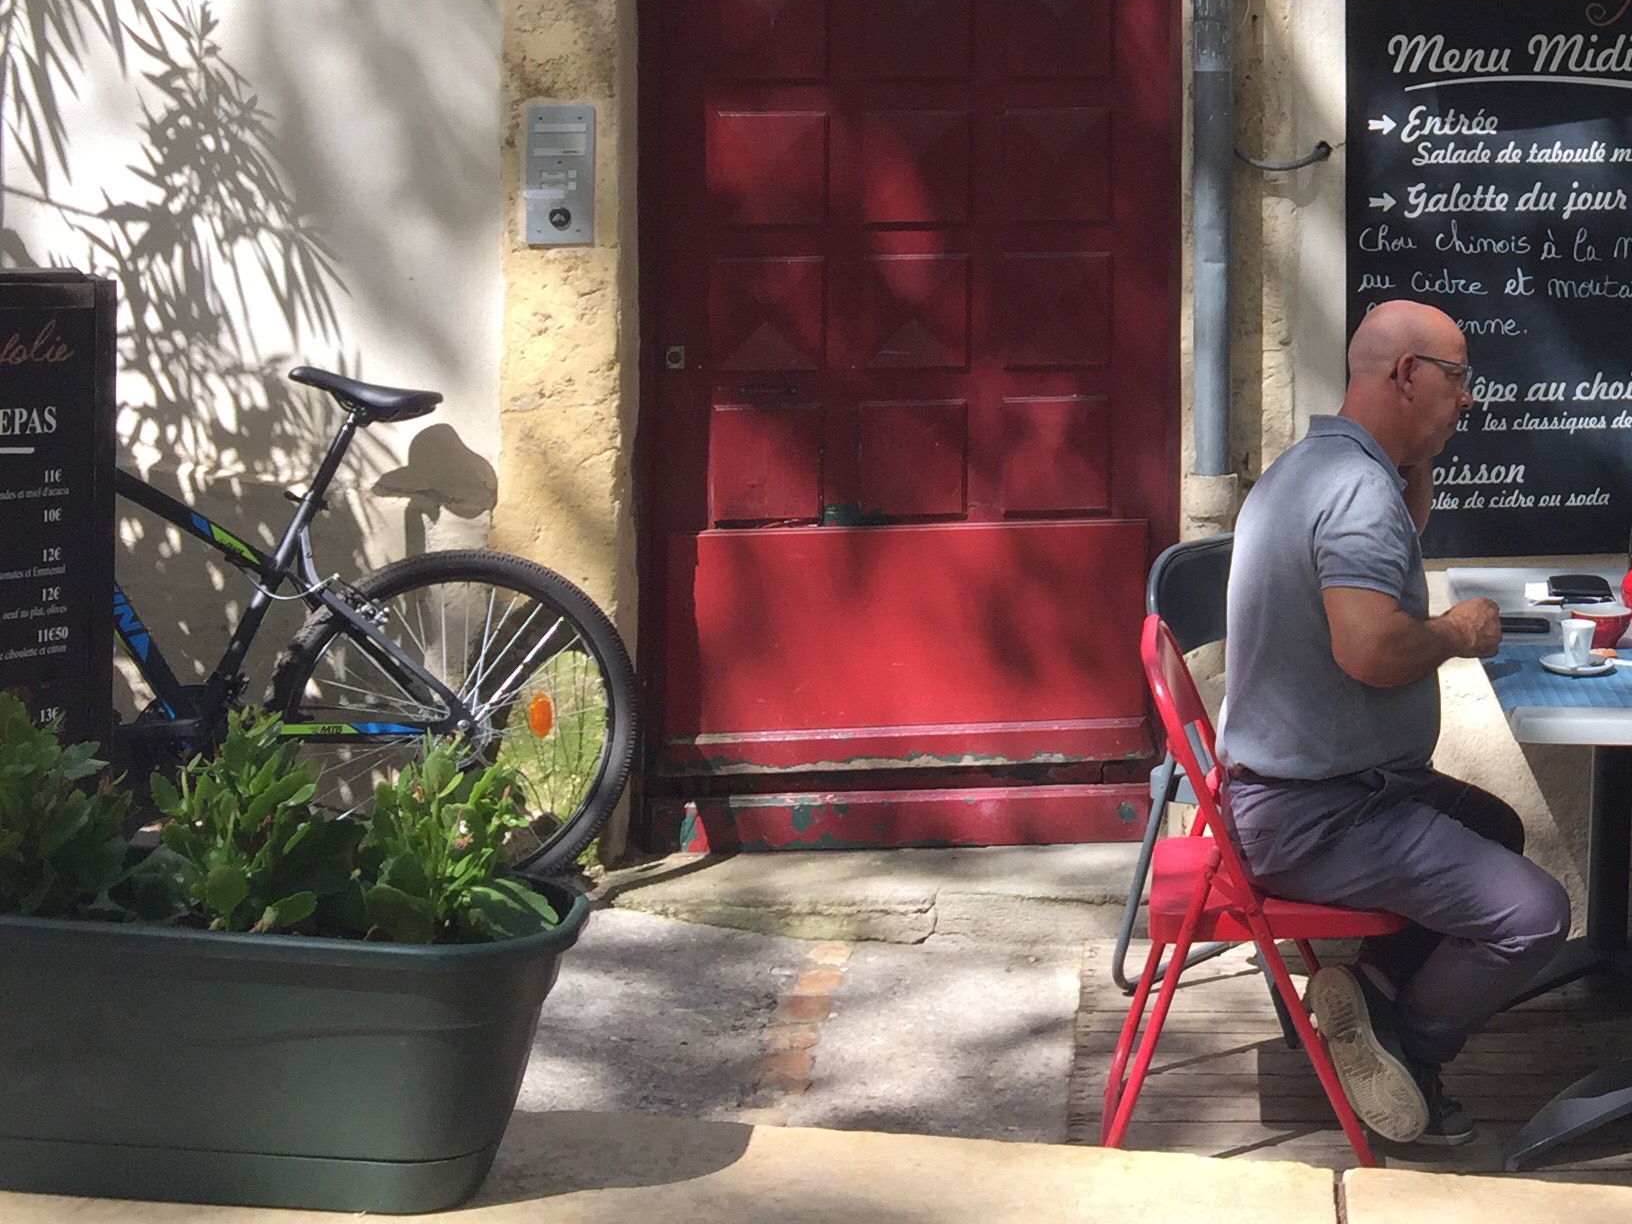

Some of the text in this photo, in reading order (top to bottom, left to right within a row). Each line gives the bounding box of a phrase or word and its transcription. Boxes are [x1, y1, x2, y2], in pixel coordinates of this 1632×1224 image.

[1388, 34, 1511, 74] Menu
[1401, 105, 1499, 143] Entrée
[1412, 141, 1492, 167] Salade
[1495, 146, 1521, 165] de
[1526, 141, 1605, 165] taboulé
[1404, 181, 1627, 219] Galette du jour
[1539, 229, 1562, 261] à
[1573, 228, 1602, 262] la
[1357, 272, 1396, 292] au
[1503, 267, 1536, 297] et
[1472, 377, 1517, 413] êpe
[1523, 380, 1565, 402] au
[0, 405, 57, 436] EPAS
[1482, 414, 1507, 432] les
[1512, 414, 1606, 435] classiques
[1611, 411, 1632, 428] de
[44, 468, 63, 483] 11€
[1433, 455, 1525, 486] oisson
[1462, 490, 1610, 510] de cidre ou soda
[43, 507, 63, 523] 10€
[42, 546, 62, 563] 12€
[42, 586, 61, 602] 12€
[38, 626, 69, 643] 11€50
